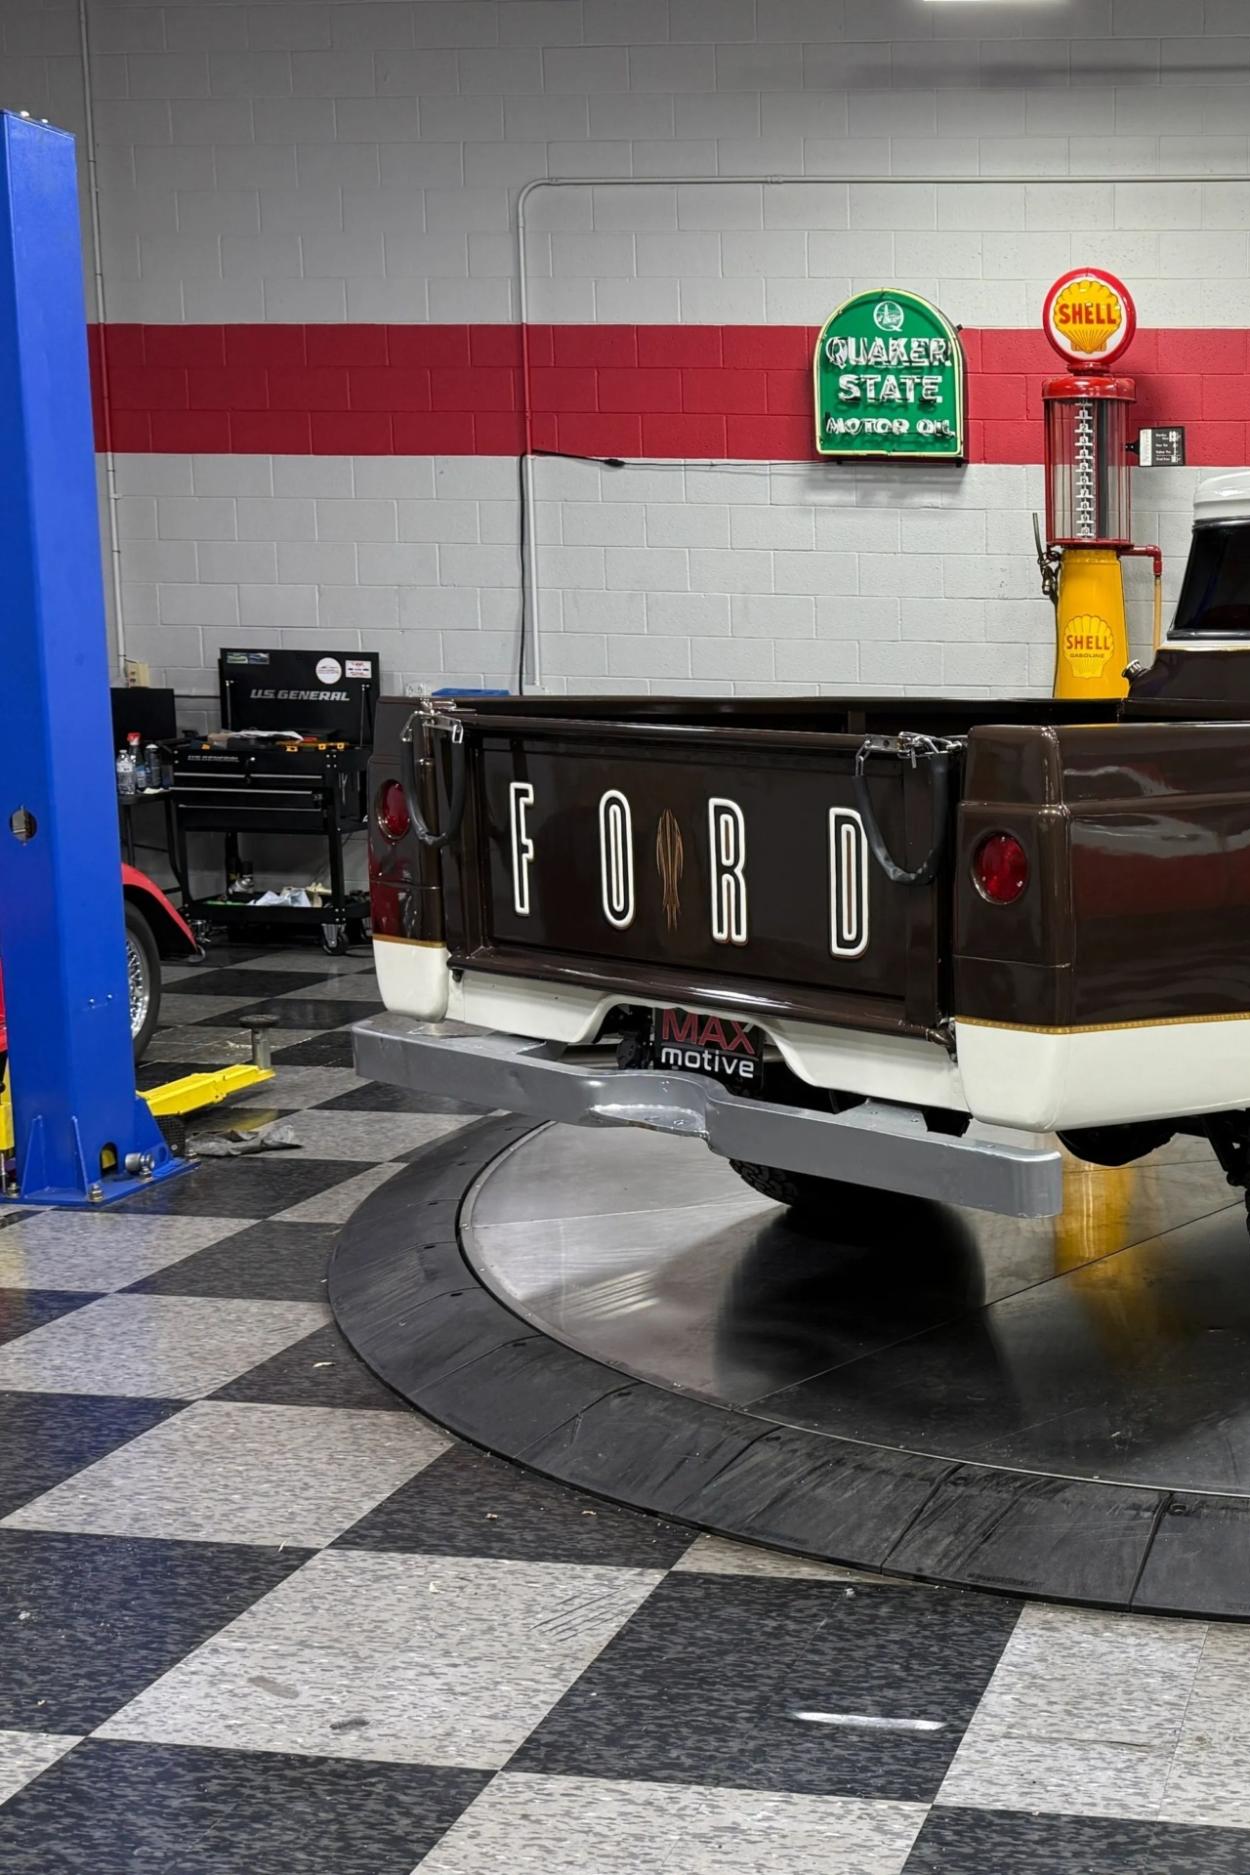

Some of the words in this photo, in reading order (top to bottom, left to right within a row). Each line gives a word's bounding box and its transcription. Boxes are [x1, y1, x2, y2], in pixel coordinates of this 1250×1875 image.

[1058, 303, 1116, 325] SHELL
[825, 336, 952, 369] QUAKER
[838, 374, 944, 403] STATE
[826, 417, 910, 434] MOTOR
[916, 418, 955, 437] OIL
[1066, 634, 1110, 650] SHELL
[277, 689, 350, 701] GENERAL
[510, 782, 869, 957] FORD
[662, 1008, 756, 1055] MAX
[661, 1047, 755, 1078] motive
